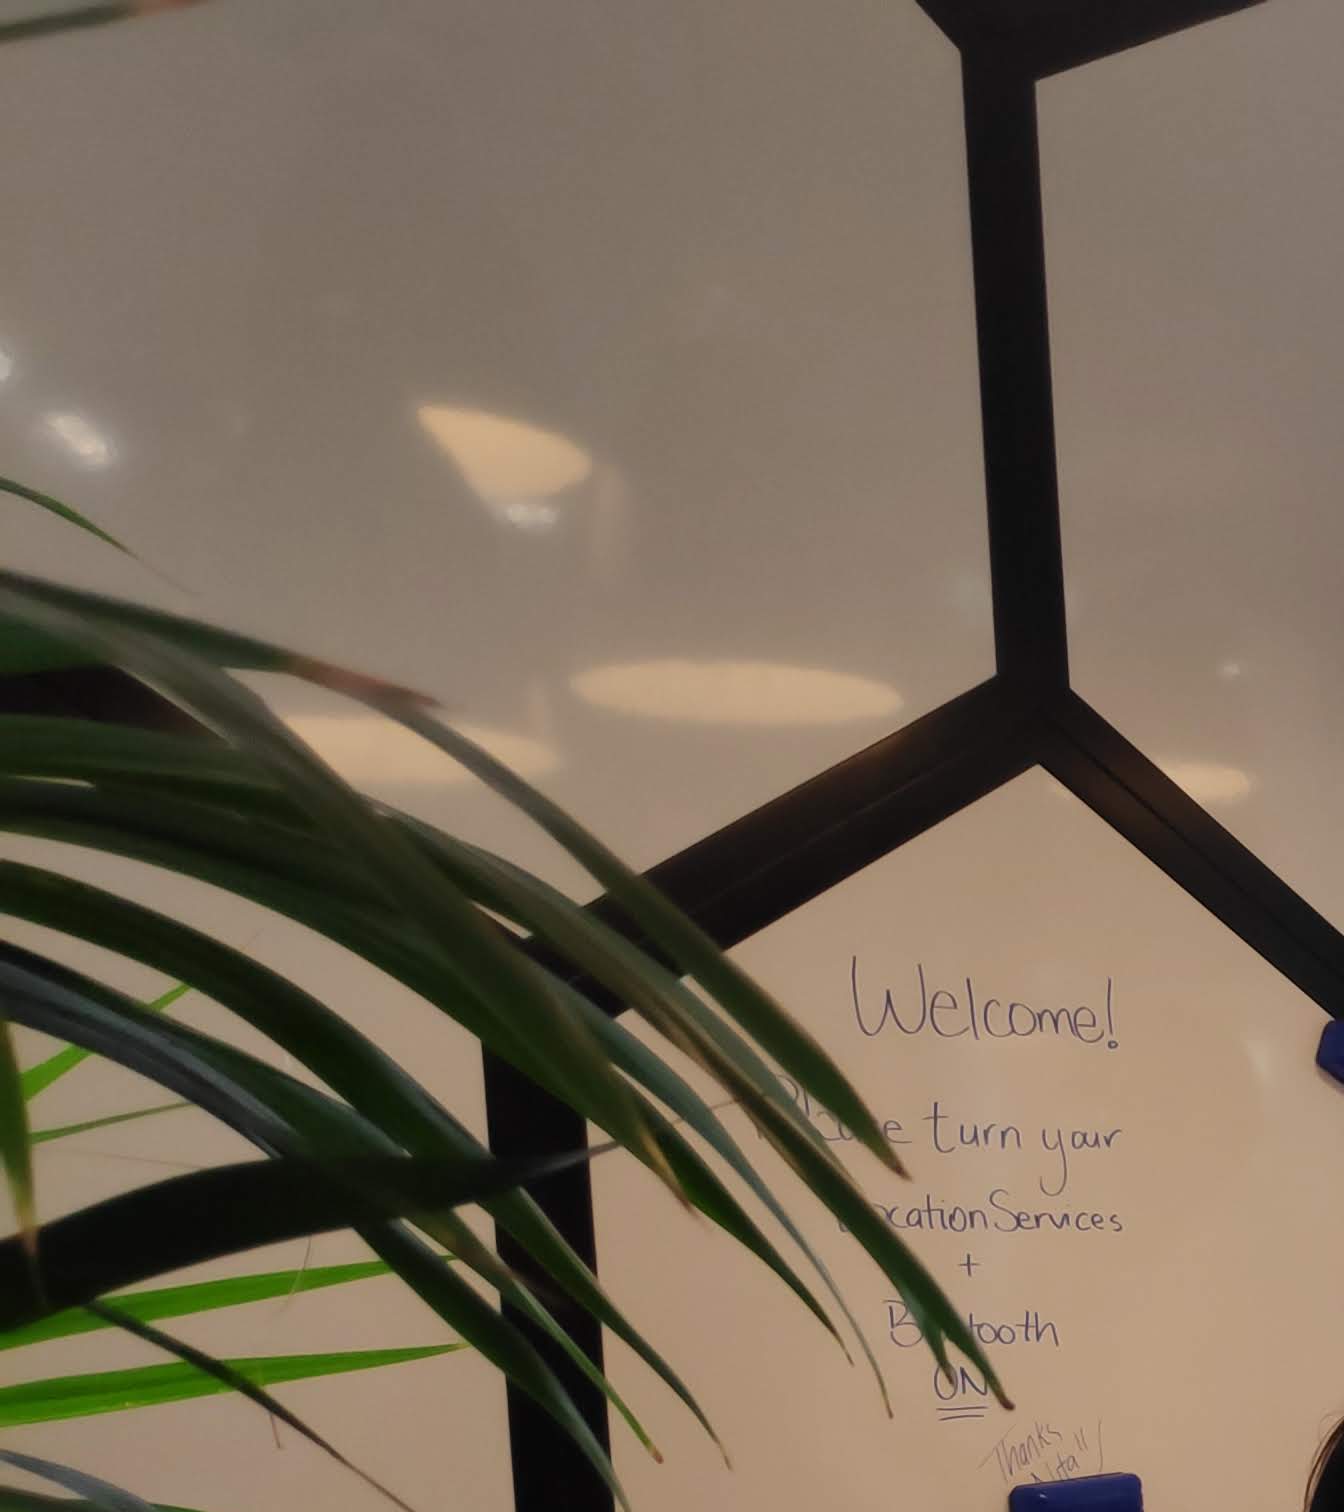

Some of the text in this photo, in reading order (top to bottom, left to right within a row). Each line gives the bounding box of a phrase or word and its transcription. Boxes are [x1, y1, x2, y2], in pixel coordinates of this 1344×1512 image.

[852, 955, 1118, 1049] Welcome!
[922, 1101, 1021, 1153] turn
[1040, 1127, 1122, 1197] your
[934, 1362, 988, 1400] ON
